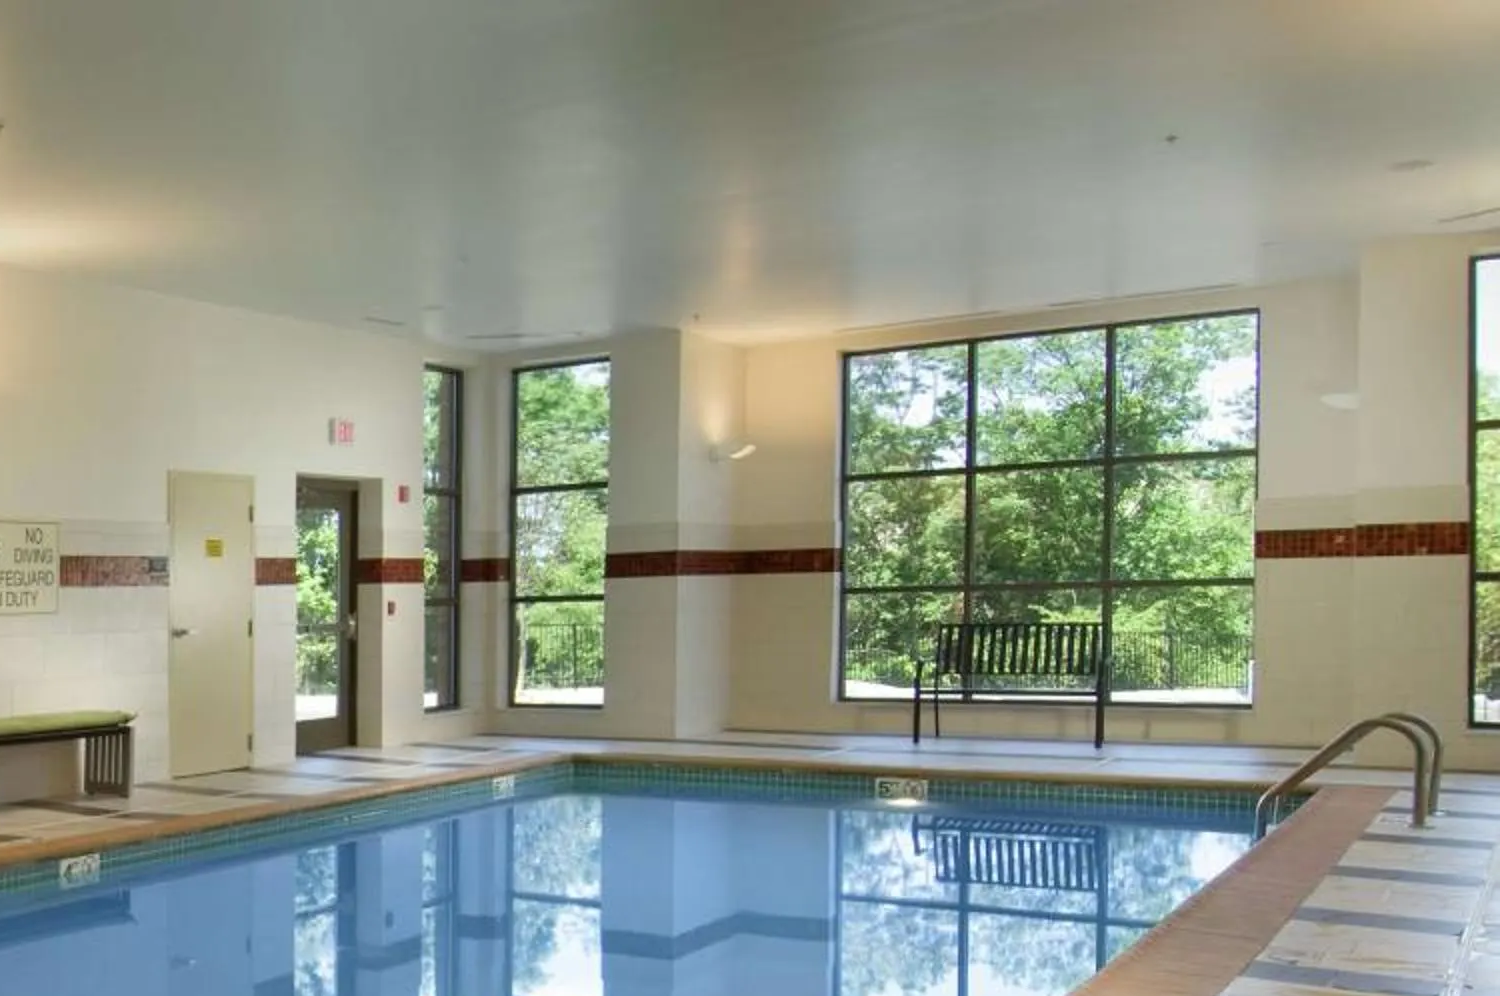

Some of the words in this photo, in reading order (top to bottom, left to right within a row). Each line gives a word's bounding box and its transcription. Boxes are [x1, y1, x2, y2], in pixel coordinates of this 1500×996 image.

[25, 527, 44, 545] NO
[13, 548, 53, 565] DIVING
[6, 591, 39, 609] DUTY
